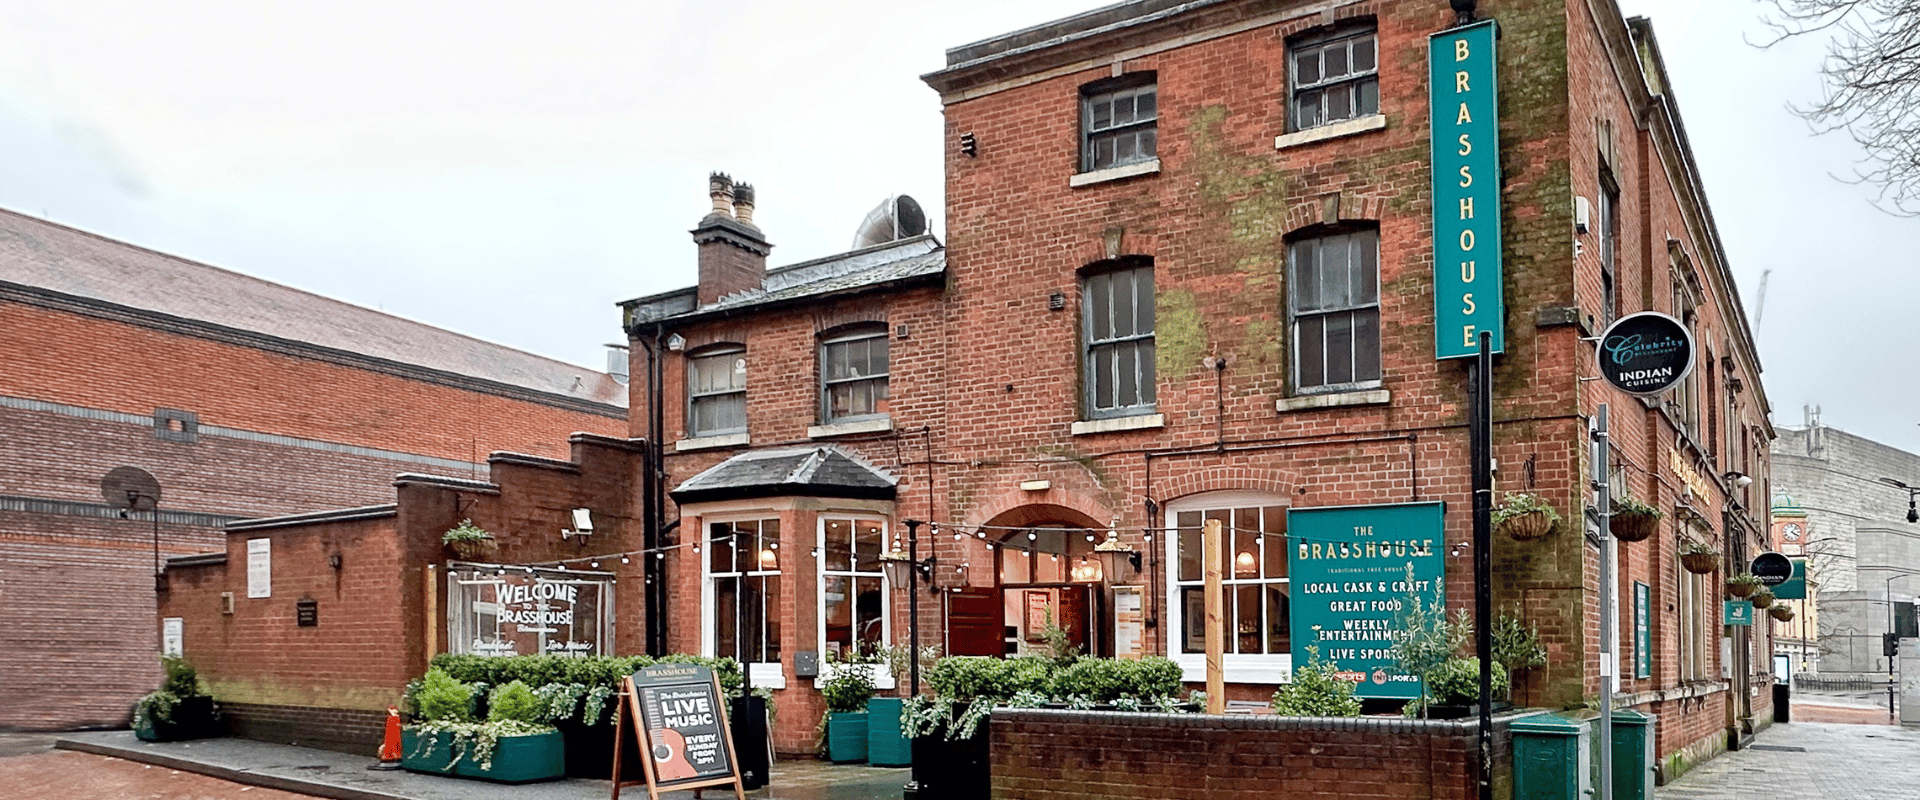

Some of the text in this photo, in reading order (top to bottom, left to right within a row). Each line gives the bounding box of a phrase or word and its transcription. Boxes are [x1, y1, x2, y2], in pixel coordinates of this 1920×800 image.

[1455, 39, 1476, 347] BRASSHOUSE
[1604, 334, 1683, 366] Celebrity
[1619, 366, 1672, 382] INDIAN
[1626, 377, 1666, 387] CUISINE
[1354, 526, 1373, 536] THE
[1299, 539, 1433, 560] BRASSHOUSE
[495, 583, 578, 604] WELCOME
[1304, 580, 1429, 594] LOCAL CASK & CRAFT
[1330, 600, 1402, 612] GREAT FOOD
[497, 610, 573, 625] BRASSHOUSE
[1343, 619, 1389, 630] WEEKLY
[1329, 649, 1355, 660] LIVE
[646, 668, 698, 677] BRASSHOUSE
[661, 698, 710, 716] LIVE
[665, 713, 713, 728] MUSIC
[685, 734, 716, 744] EVERY
[687, 742, 718, 752] SUNDAY
[693, 750, 715, 759] FROM
